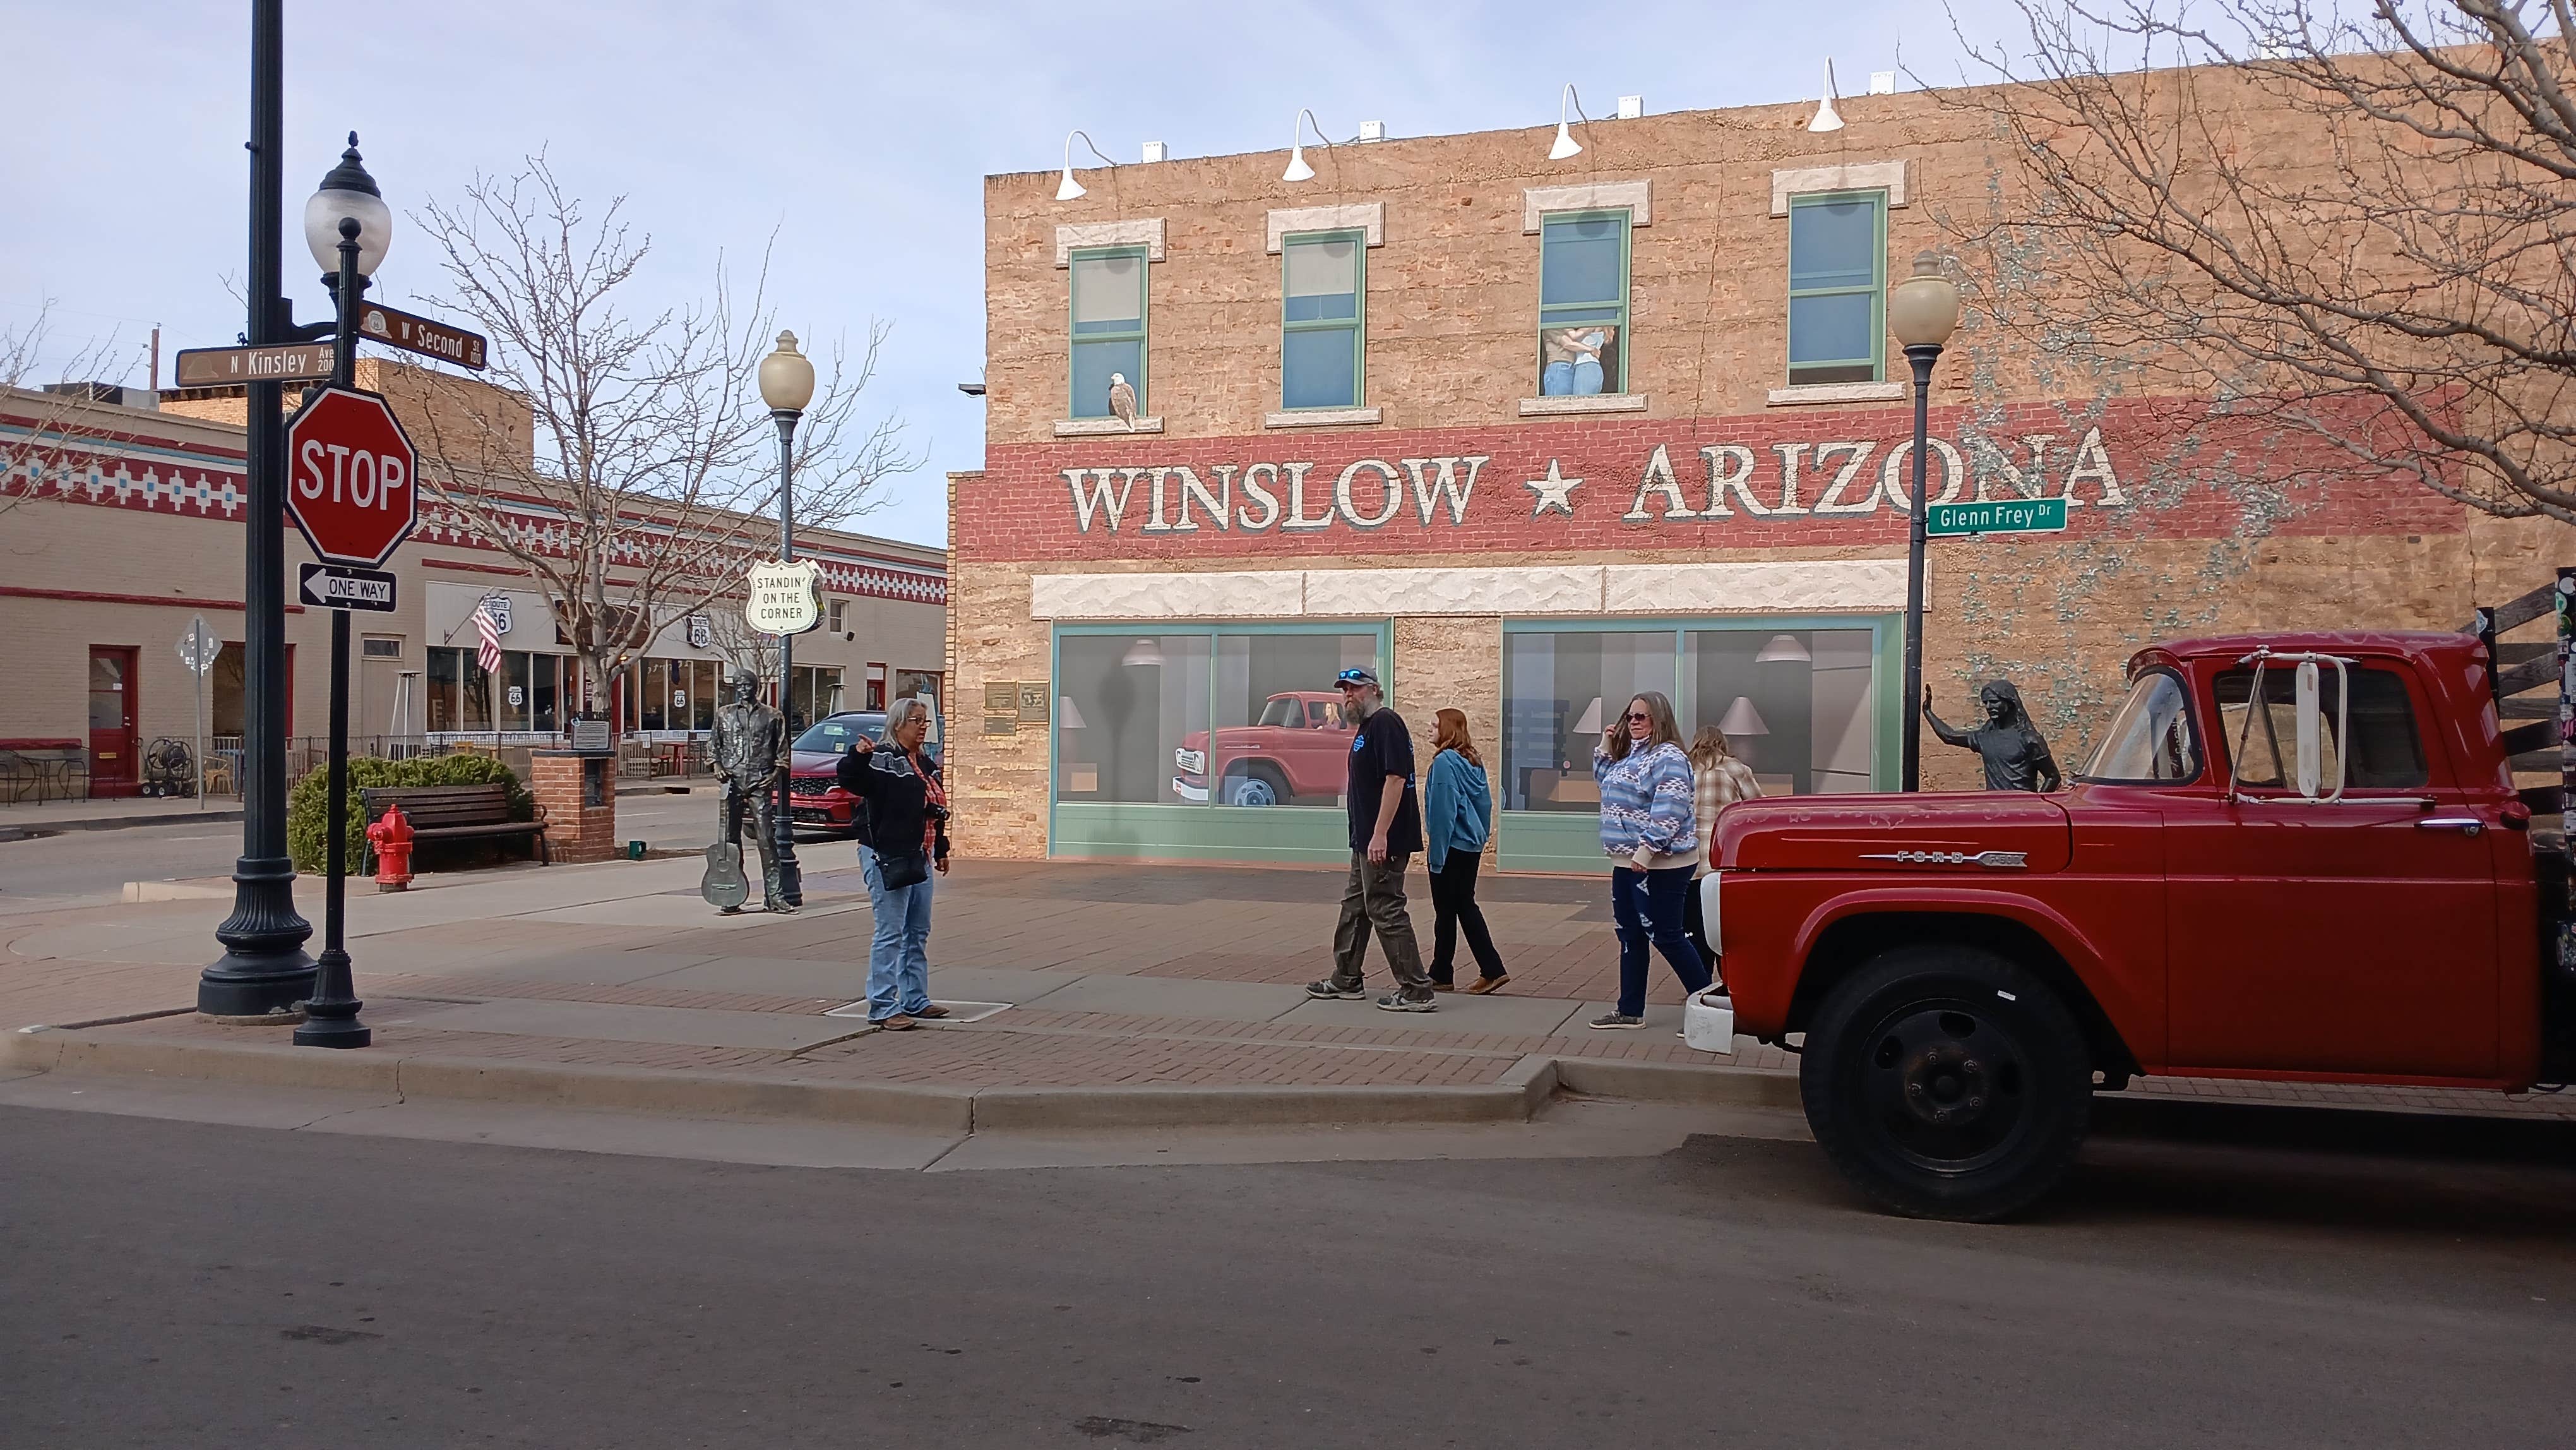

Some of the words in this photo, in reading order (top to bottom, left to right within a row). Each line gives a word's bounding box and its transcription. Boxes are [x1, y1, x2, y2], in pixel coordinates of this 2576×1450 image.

[402, 321, 410, 339] W
[417, 324, 463, 358] Second
[473, 340, 480, 352] St
[319, 347, 334, 359] Ave
[470, 351, 481, 364] 100
[231, 356, 238, 373] N
[248, 351, 306, 375] Kinsley
[318, 359, 334, 371] 200
[299, 439, 405, 510] STOP
[1621, 424, 2128, 520] ARIZONA
[1059, 453, 1490, 536] WINSLOW
[1941, 509, 1989, 527] Glenn
[1996, 506, 2034, 528] Frey
[2039, 504, 2051, 516] Dr
[329, 578, 355, 596] ONE
[360, 581, 386, 599] WAY
[757, 577, 806, 589] STANDIN'
[763, 593, 777, 604] ON
[780, 592, 800, 603] THE
[761, 608, 802, 619] CORNER
[511, 693, 521, 703] 66
[1897, 850, 1964, 863] FORD
